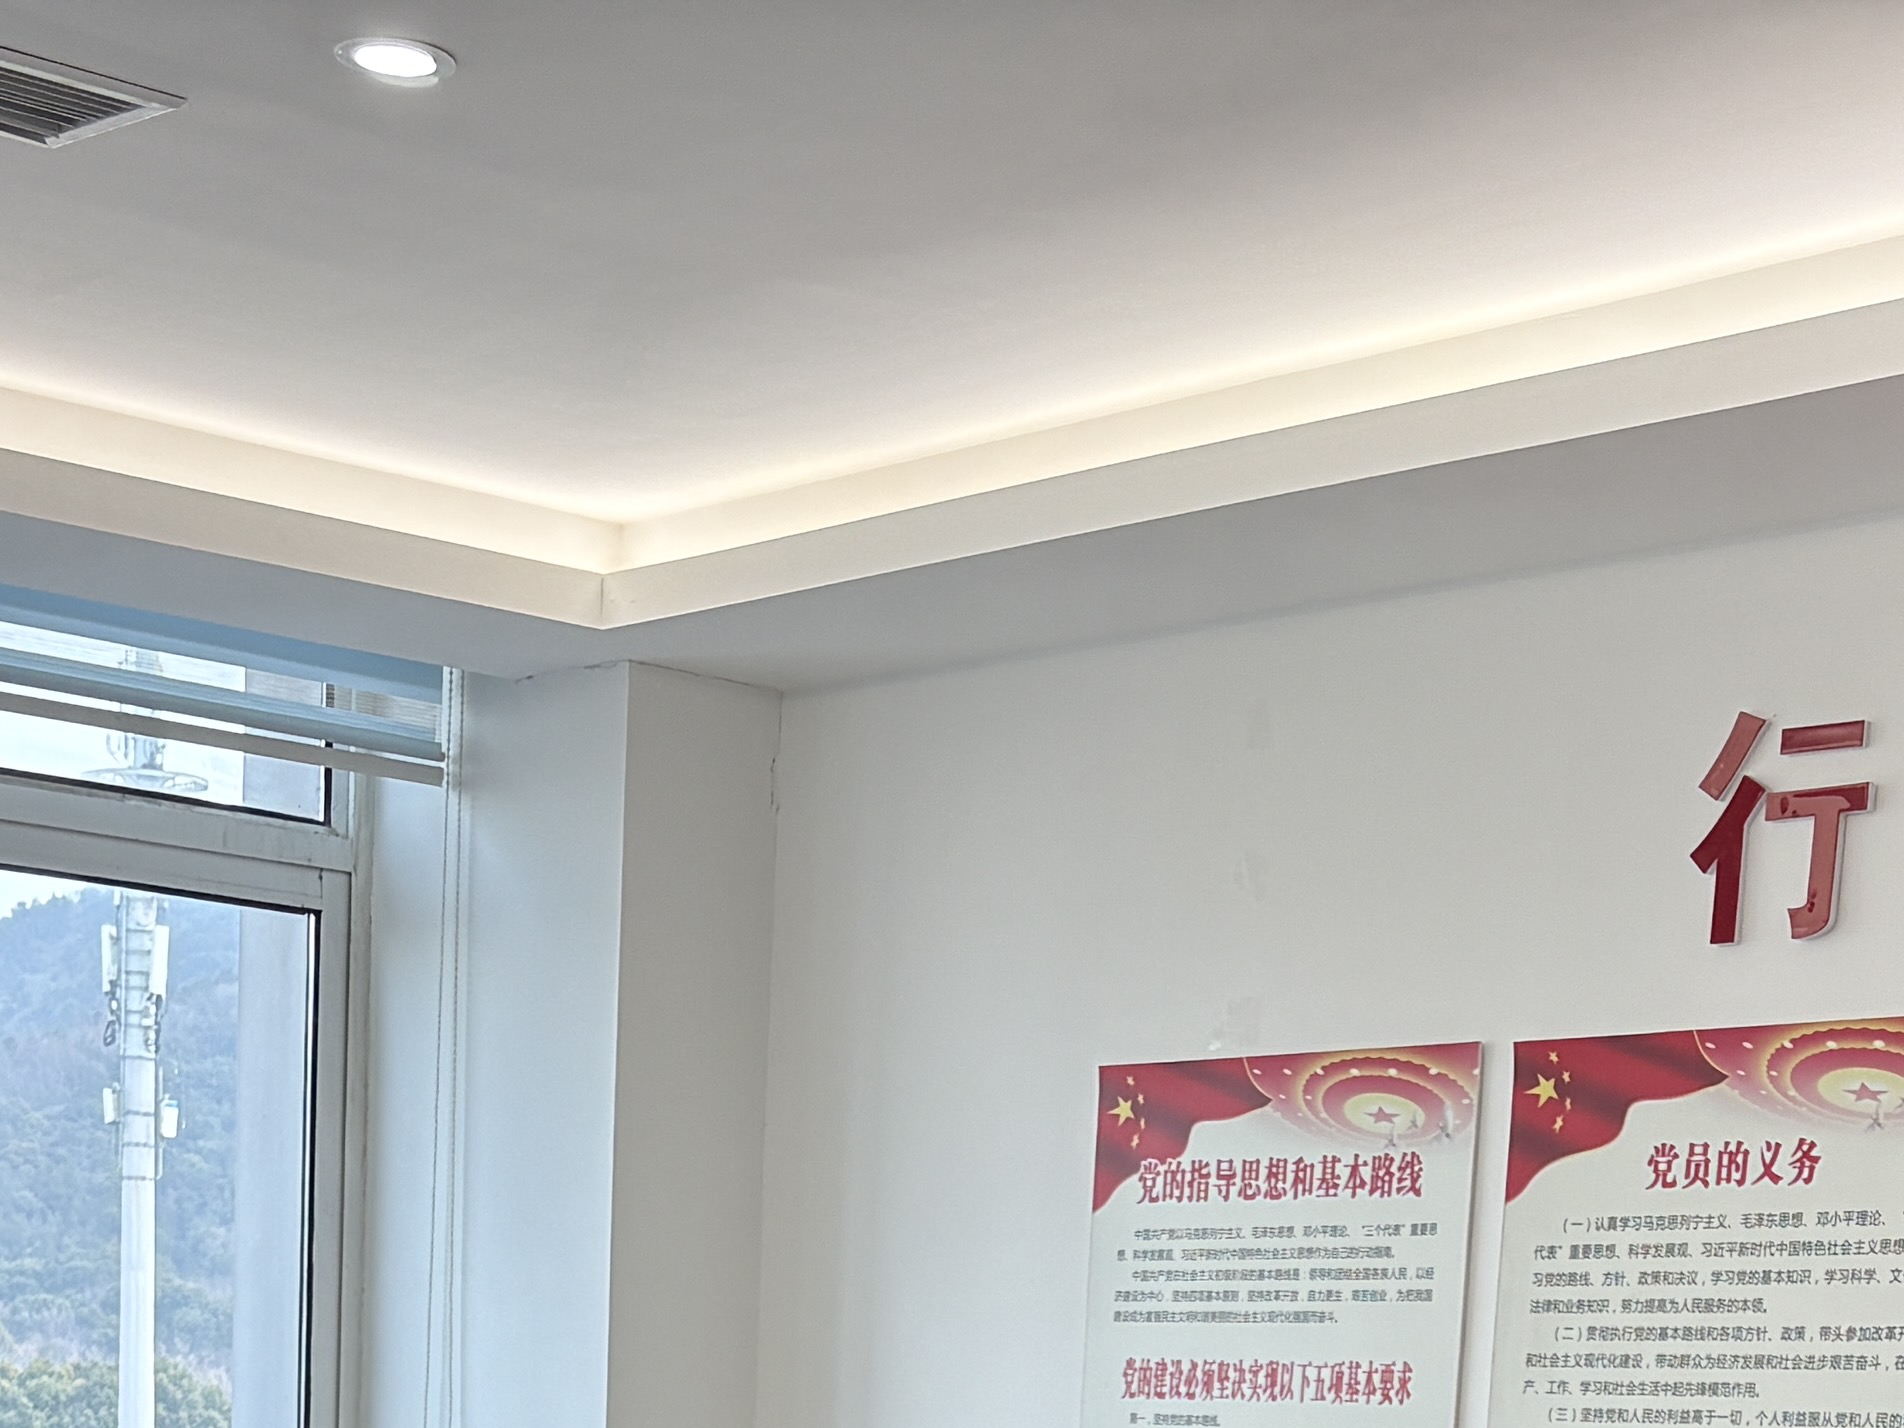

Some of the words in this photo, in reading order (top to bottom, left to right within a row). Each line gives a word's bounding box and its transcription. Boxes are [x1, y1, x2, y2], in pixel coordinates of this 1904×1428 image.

[1137, 1151, 1424, 1204] 党的指导思想和基本路线
[1645, 1137, 1822, 1190] 党员的义务
[1121, 1356, 1414, 1406] 党的建设必须坚决实现以下五项基本要求
